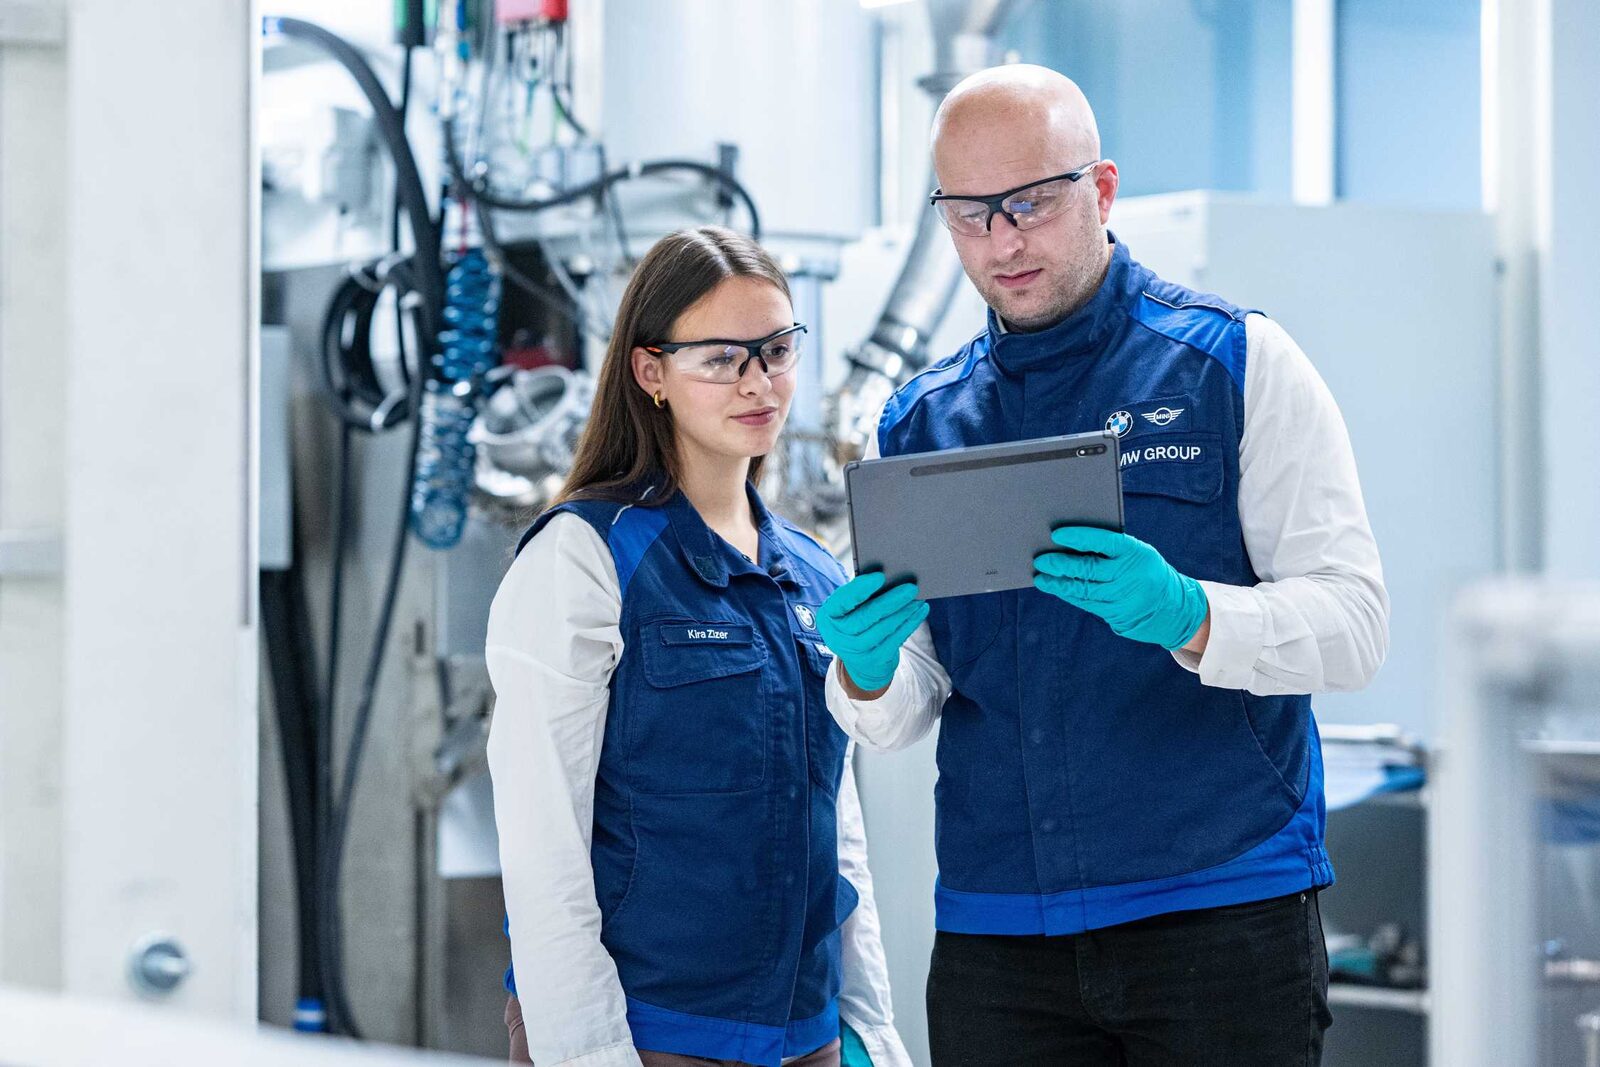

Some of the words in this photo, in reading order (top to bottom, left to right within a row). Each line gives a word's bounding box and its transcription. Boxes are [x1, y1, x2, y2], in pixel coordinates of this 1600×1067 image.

[1120, 449, 1141, 467] MW
[1143, 445, 1201, 461] GROUP
[687, 629, 706, 639] Kira
[706, 629, 729, 640] Zizer
